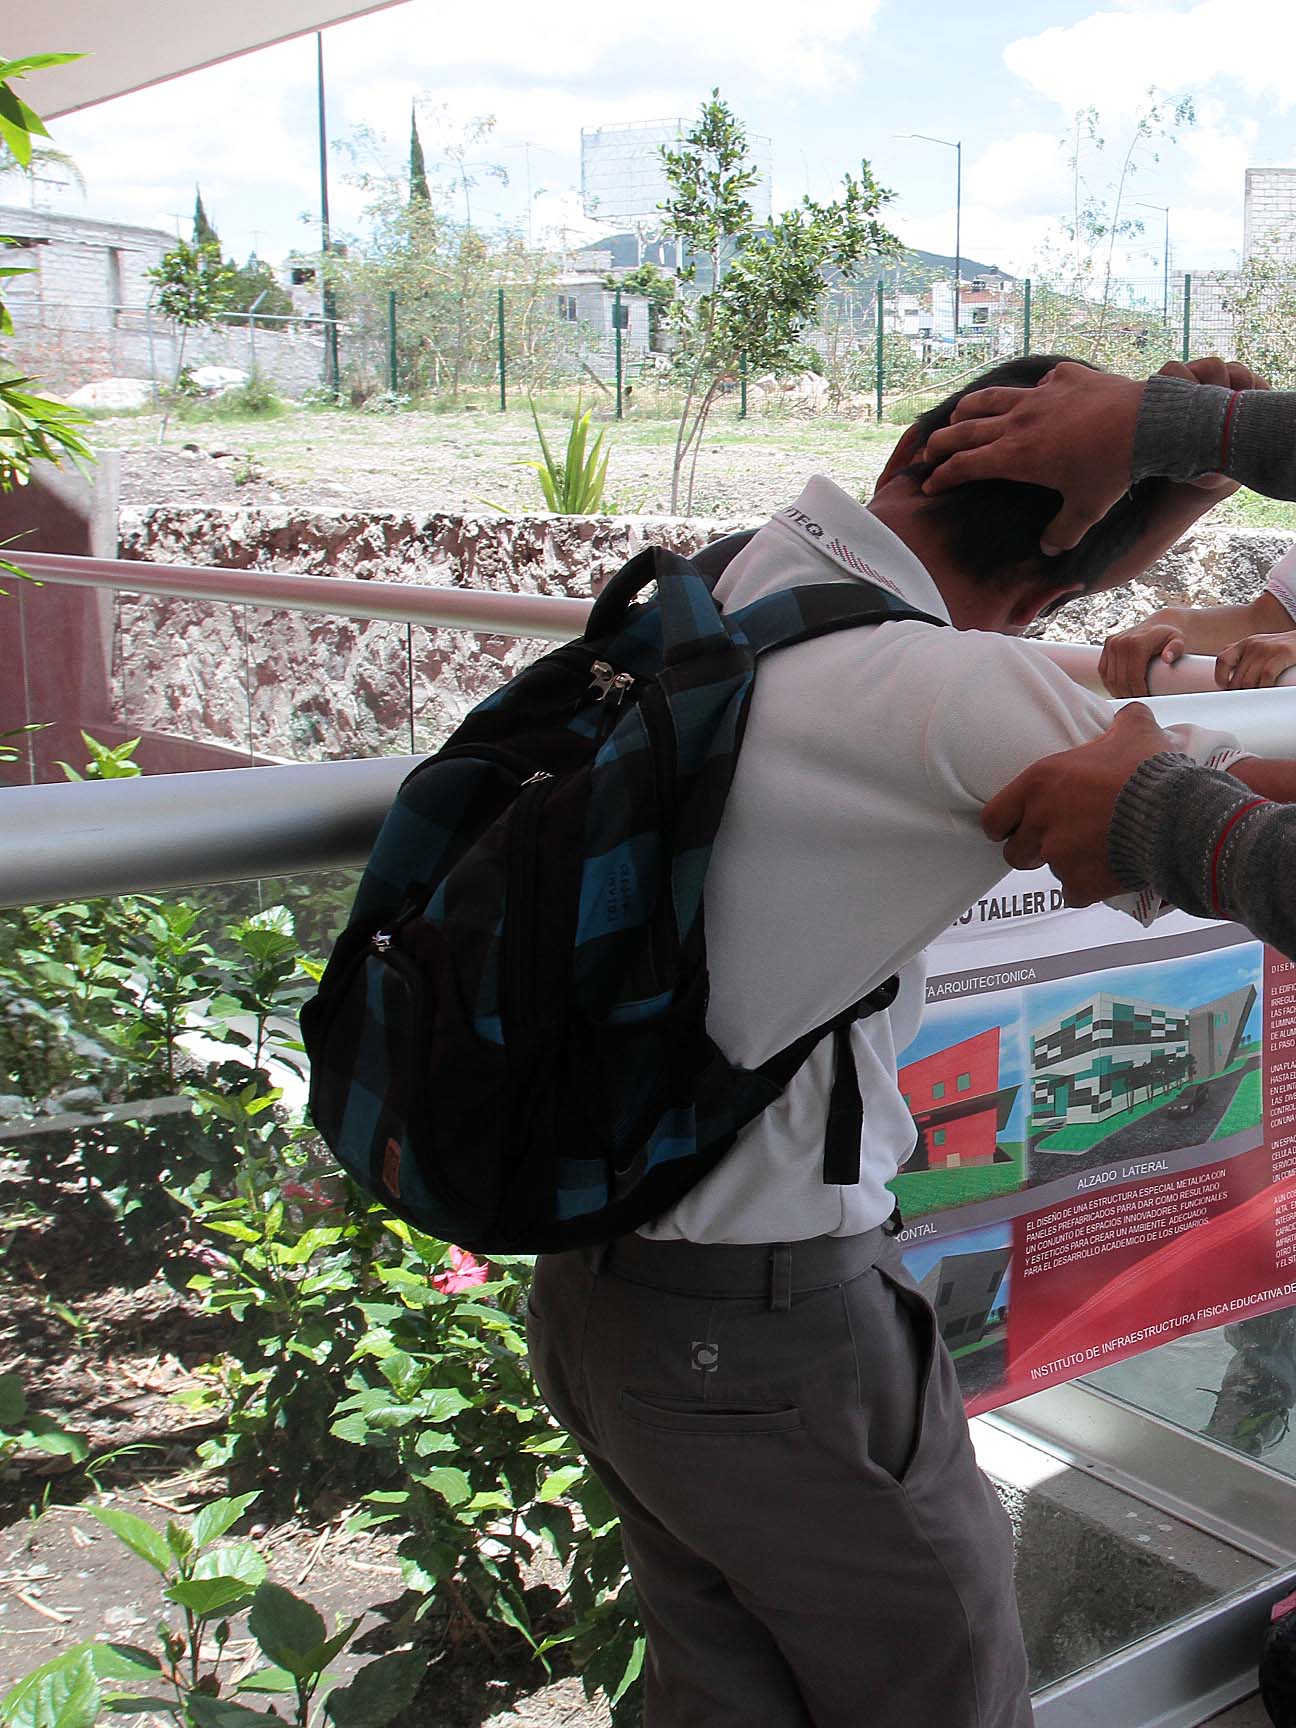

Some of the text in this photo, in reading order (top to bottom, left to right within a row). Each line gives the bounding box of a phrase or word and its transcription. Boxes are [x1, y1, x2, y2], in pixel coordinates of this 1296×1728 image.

[978, 891, 1045, 921] TALLER
[936, 968, 1036, 996] ARQUITECTONICA
[1271, 1009, 1282, 1017] LAS
[1270, 1031, 1278, 1040] DE
[1270, 1042, 1277, 1050] EL
[1278, 1038, 1295, 1049] PASO
[1270, 1072, 1289, 1084] HASTA
[1289, 1070, 1296, 1079] EL
[1270, 1086, 1278, 1095] EN
[1271, 1096, 1282, 1105] LAS
[1270, 1117, 1282, 1127] CON
[1271, 1140, 1279, 1149] UN
[1271, 1147, 1292, 1160] CELULA
[1271, 1157, 1296, 1171] SERVICIO
[1077, 1160, 1168, 1190] ALZADO LATERAL
[1026, 1168, 1225, 1230] EL DISEÑO DE UNA ESTRUCTURA ESPECIAL METALICA CON
[1026, 1181, 1220, 1242] PANELES PREFABRICADOS PARA DAR COMO RESULTADO
[1025, 1243, 1036, 1254] UN
[1037, 1230, 1074, 1250] CONJUNTO
[1074, 1227, 1085, 1237] DE
[1086, 1217, 1121, 1233] ESPACIOS
[1180, 1191, 1227, 1210] FUNCIONALES
[1031, 1244, 1069, 1263] ESTETICOS
[1070, 1237, 1089, 1250] PARA
[1089, 1230, 1114, 1244] CREAR
[1115, 1227, 1126, 1237] UN
[1127, 1218, 1166, 1234] AMBIENTE
[1168, 1207, 1206, 1224] ADECUADO
[1023, 1264, 1042, 1277] PARA
[1043, 1260, 1052, 1270] EL
[1053, 1246, 1100, 1267] DESARROLLO
[1101, 1234, 1145, 1252] ACADEMICO
[1146, 1232, 1156, 1241] DE
[1158, 1227, 1173, 1238] LOS
[1275, 1246, 1291, 1257] OTRO
[1280, 1257, 1287, 1266] EL
[1030, 1351, 1083, 1381] INSTITUTO
[1085, 1344, 1100, 1360] DE
[1102, 1311, 1195, 1353] INFRAESTRUCTURA
[1197, 1301, 1229, 1320] FISICA
[1230, 1285, 1283, 1311] EDUCATIVA
